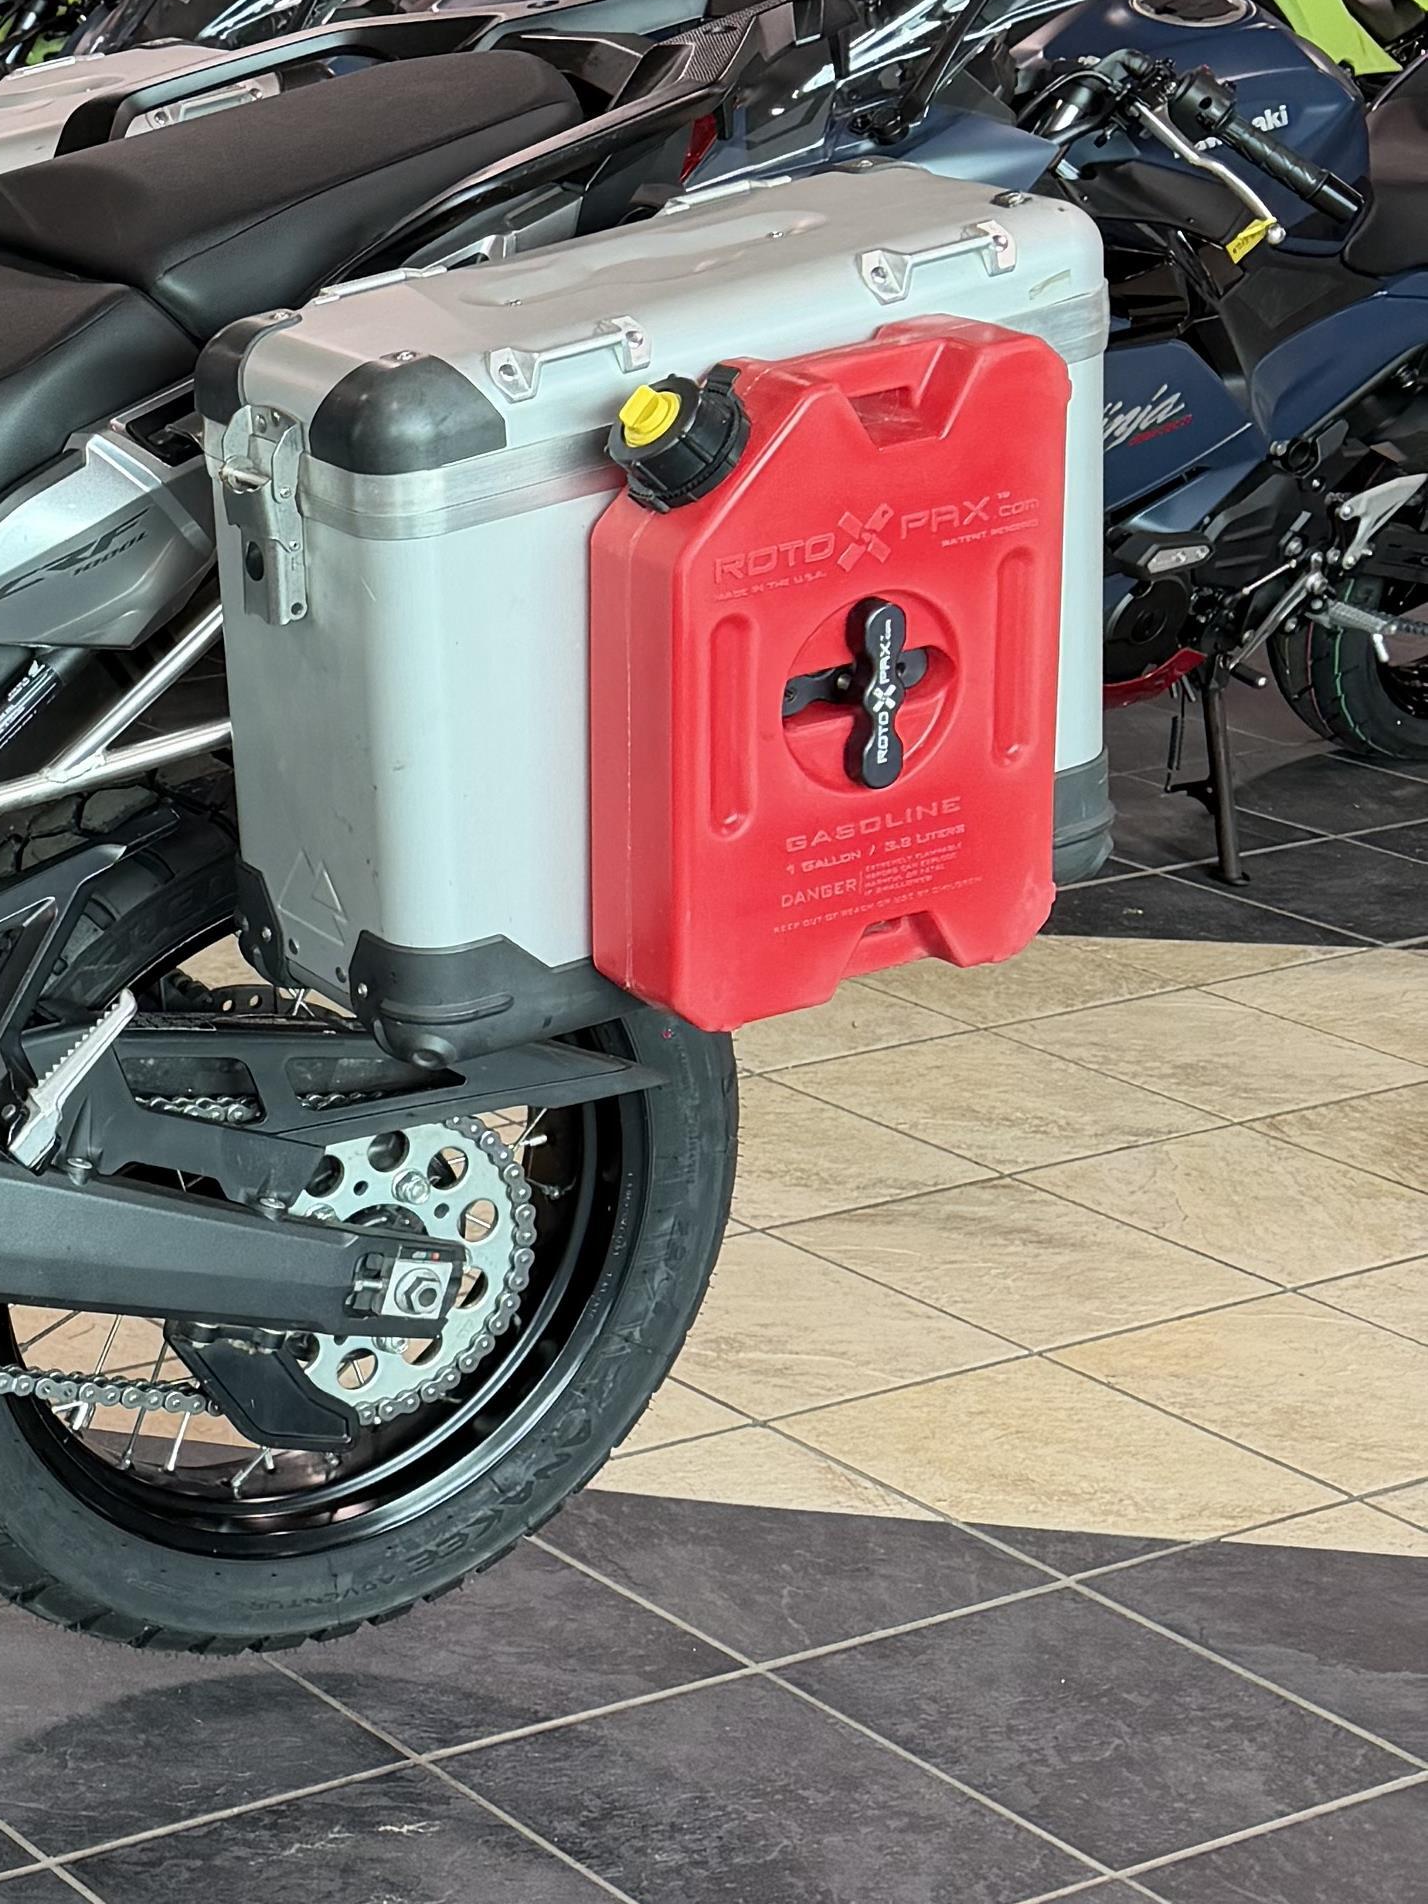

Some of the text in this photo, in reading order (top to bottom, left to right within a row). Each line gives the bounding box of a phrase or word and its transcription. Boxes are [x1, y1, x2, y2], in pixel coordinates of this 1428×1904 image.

[1103, 384, 1185, 451] inja
[714, 532, 836, 585] ROTO
[877, 711, 889, 764] ROTO
[786, 796, 961, 853] GASOLINE
[786, 863, 795, 875] 1
[801, 850, 861, 872] GALLON
[884, 836, 912, 852] 3.8
[916, 824, 966, 844] LITERS
[781, 878, 857, 908] DANGER
[802, 915, 823, 928] OUT
